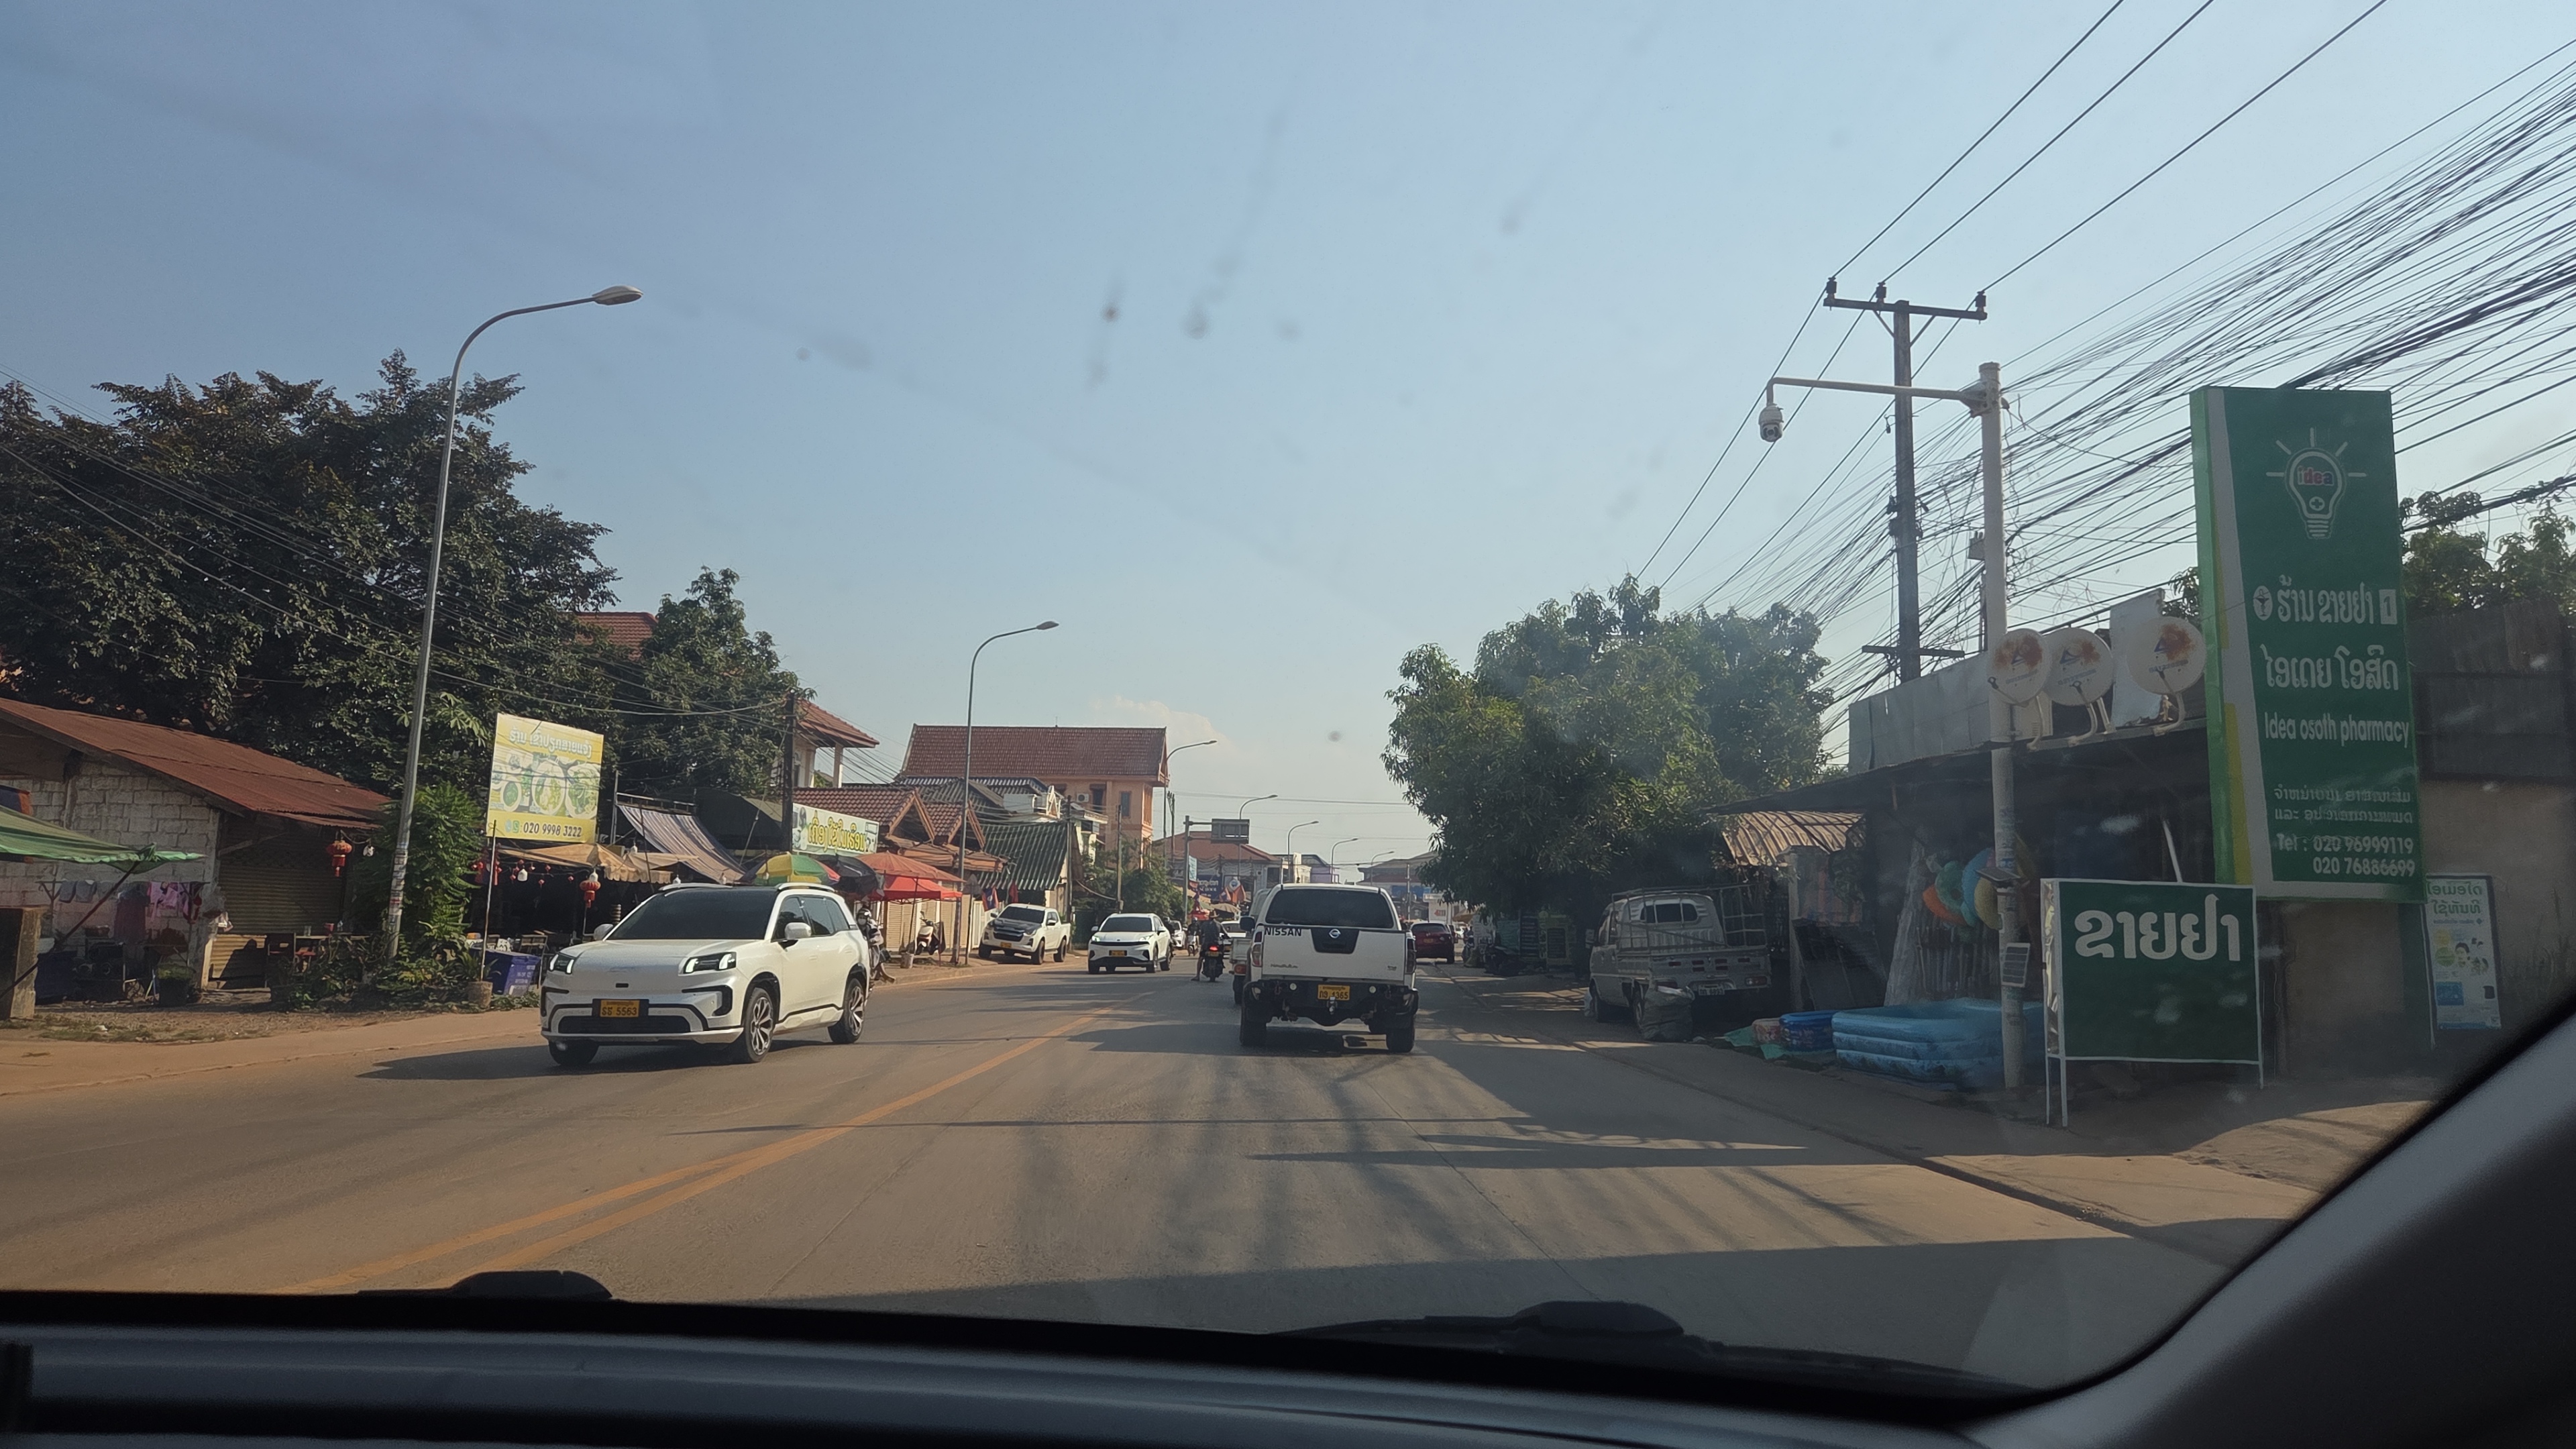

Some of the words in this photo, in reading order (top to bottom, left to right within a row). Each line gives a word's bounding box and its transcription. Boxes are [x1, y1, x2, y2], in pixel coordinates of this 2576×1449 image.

[2297, 465, 2334, 485] idea
[2264, 711, 2296, 739] Idea
[2300, 712, 2337, 741] osoth
[2340, 714, 2410, 749] pharmacy
[523, 822, 539, 834] 020
[542, 823, 561, 836] 9998
[563, 825, 582, 837] 3222
[2313, 835, 2341, 852] 020
[2313, 857, 2340, 874] 020
[1265, 927, 1302, 936] NISSAN
[2074, 894, 2241, 961] ຂາຍຢາ
[616, 1006, 637, 1016] 5563
